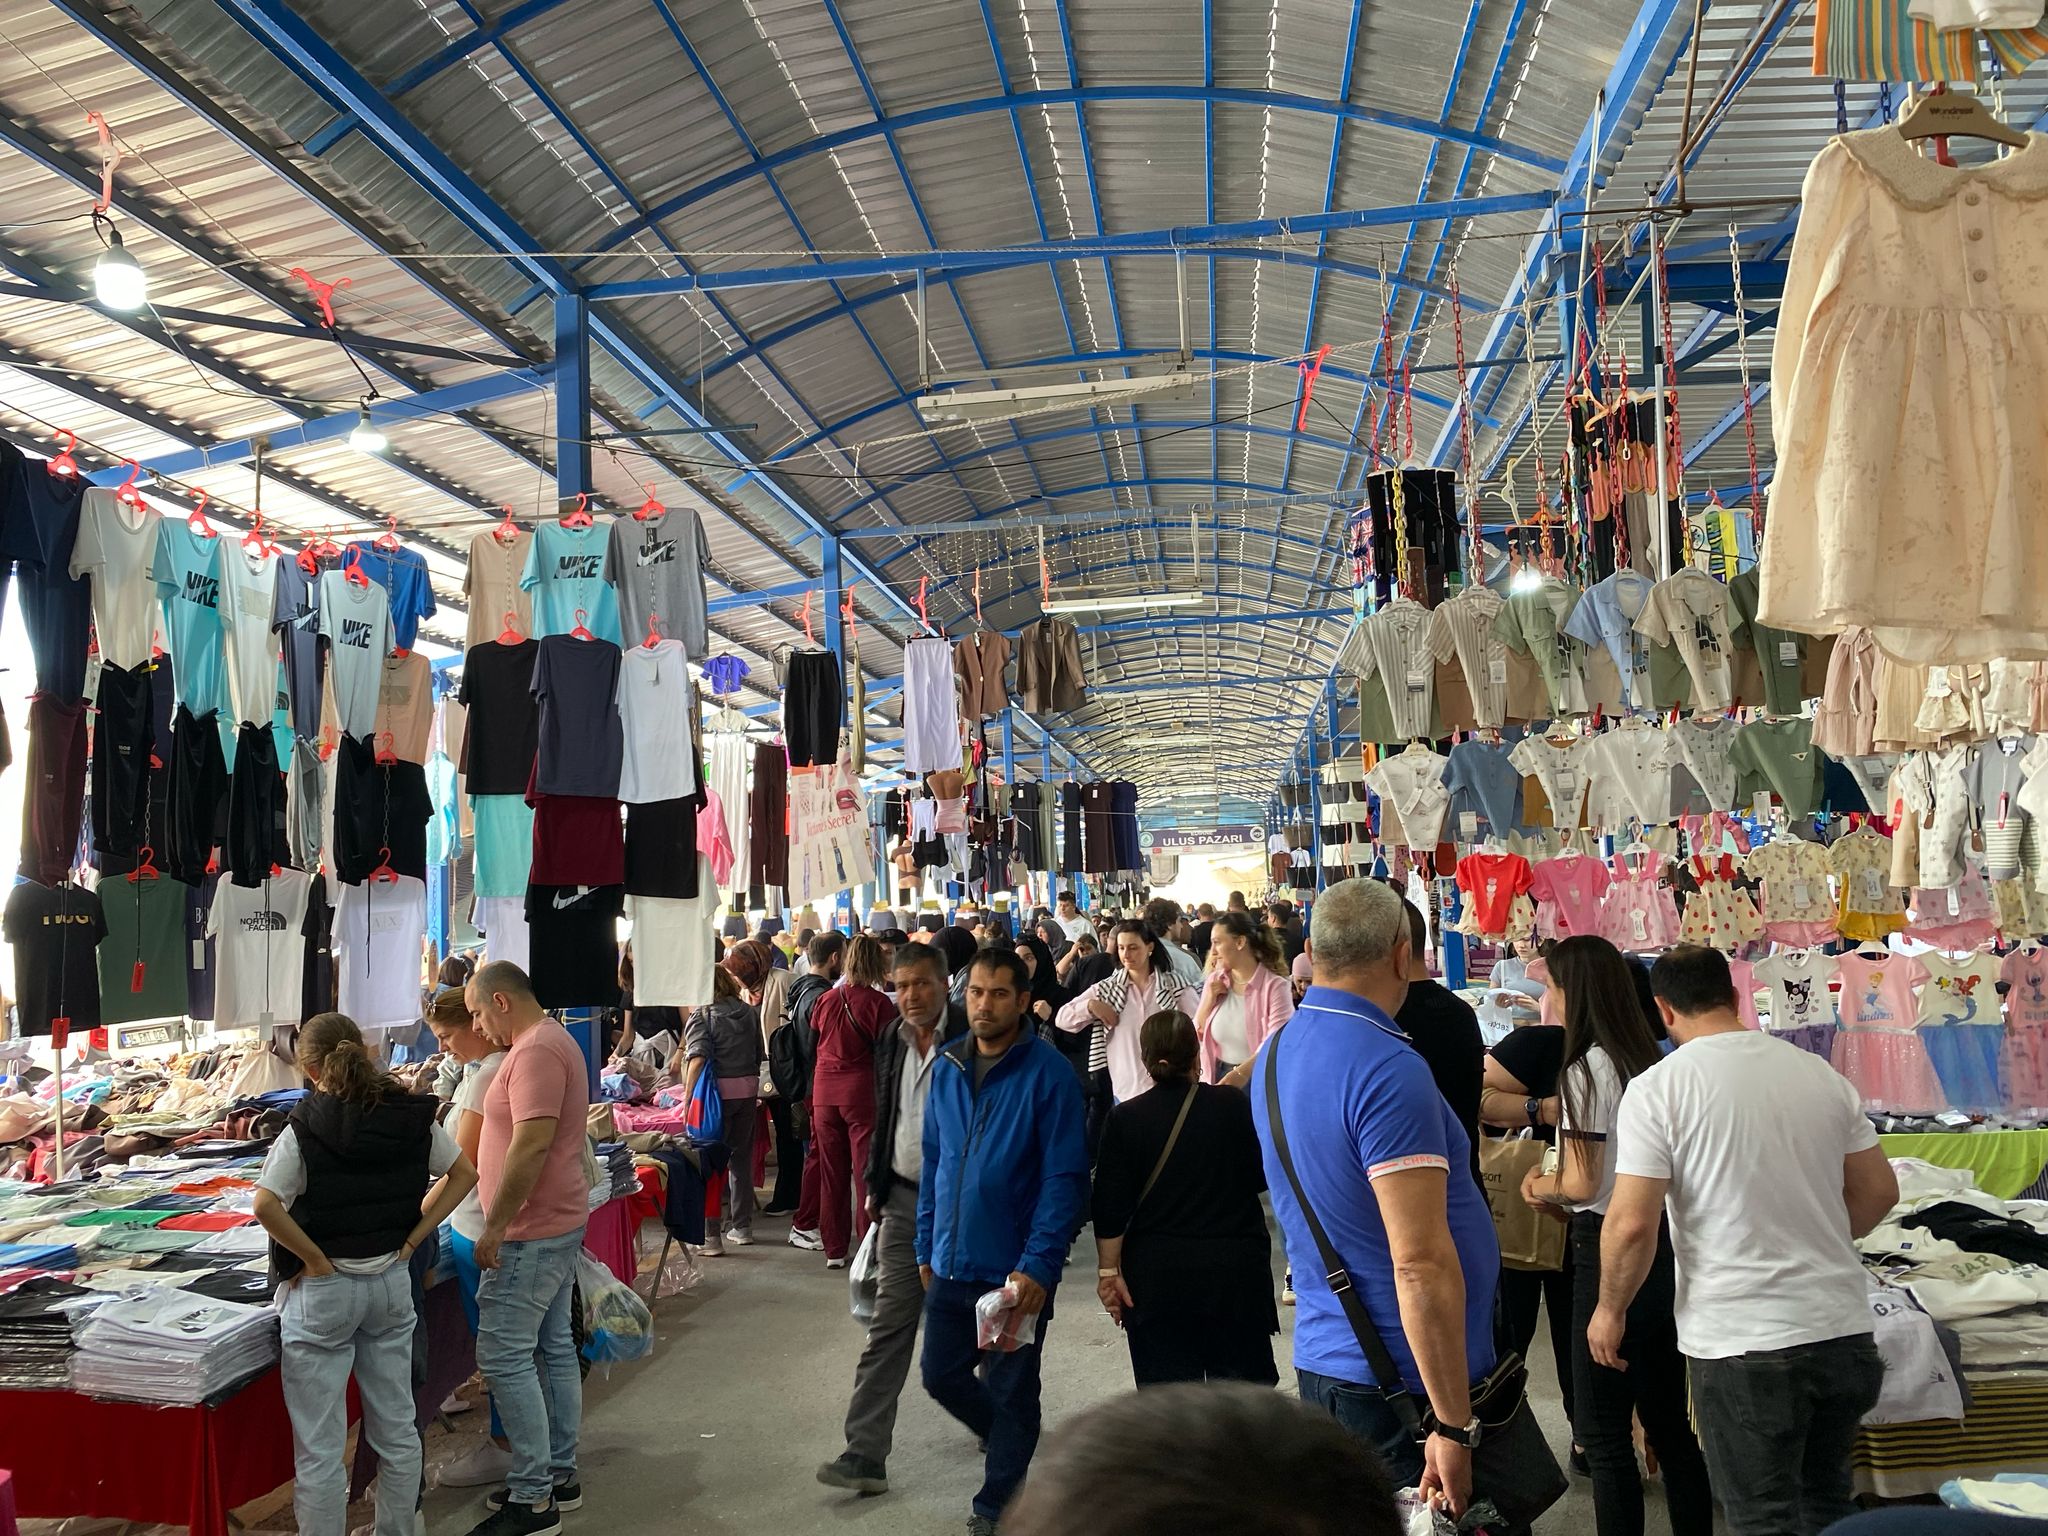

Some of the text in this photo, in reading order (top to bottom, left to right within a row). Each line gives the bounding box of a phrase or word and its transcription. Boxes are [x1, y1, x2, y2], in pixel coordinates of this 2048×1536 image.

[554, 555, 602, 579] NIKE
[340, 619, 373, 649] NIKE
[1162, 834, 1243, 847] ULUS PAZARI
